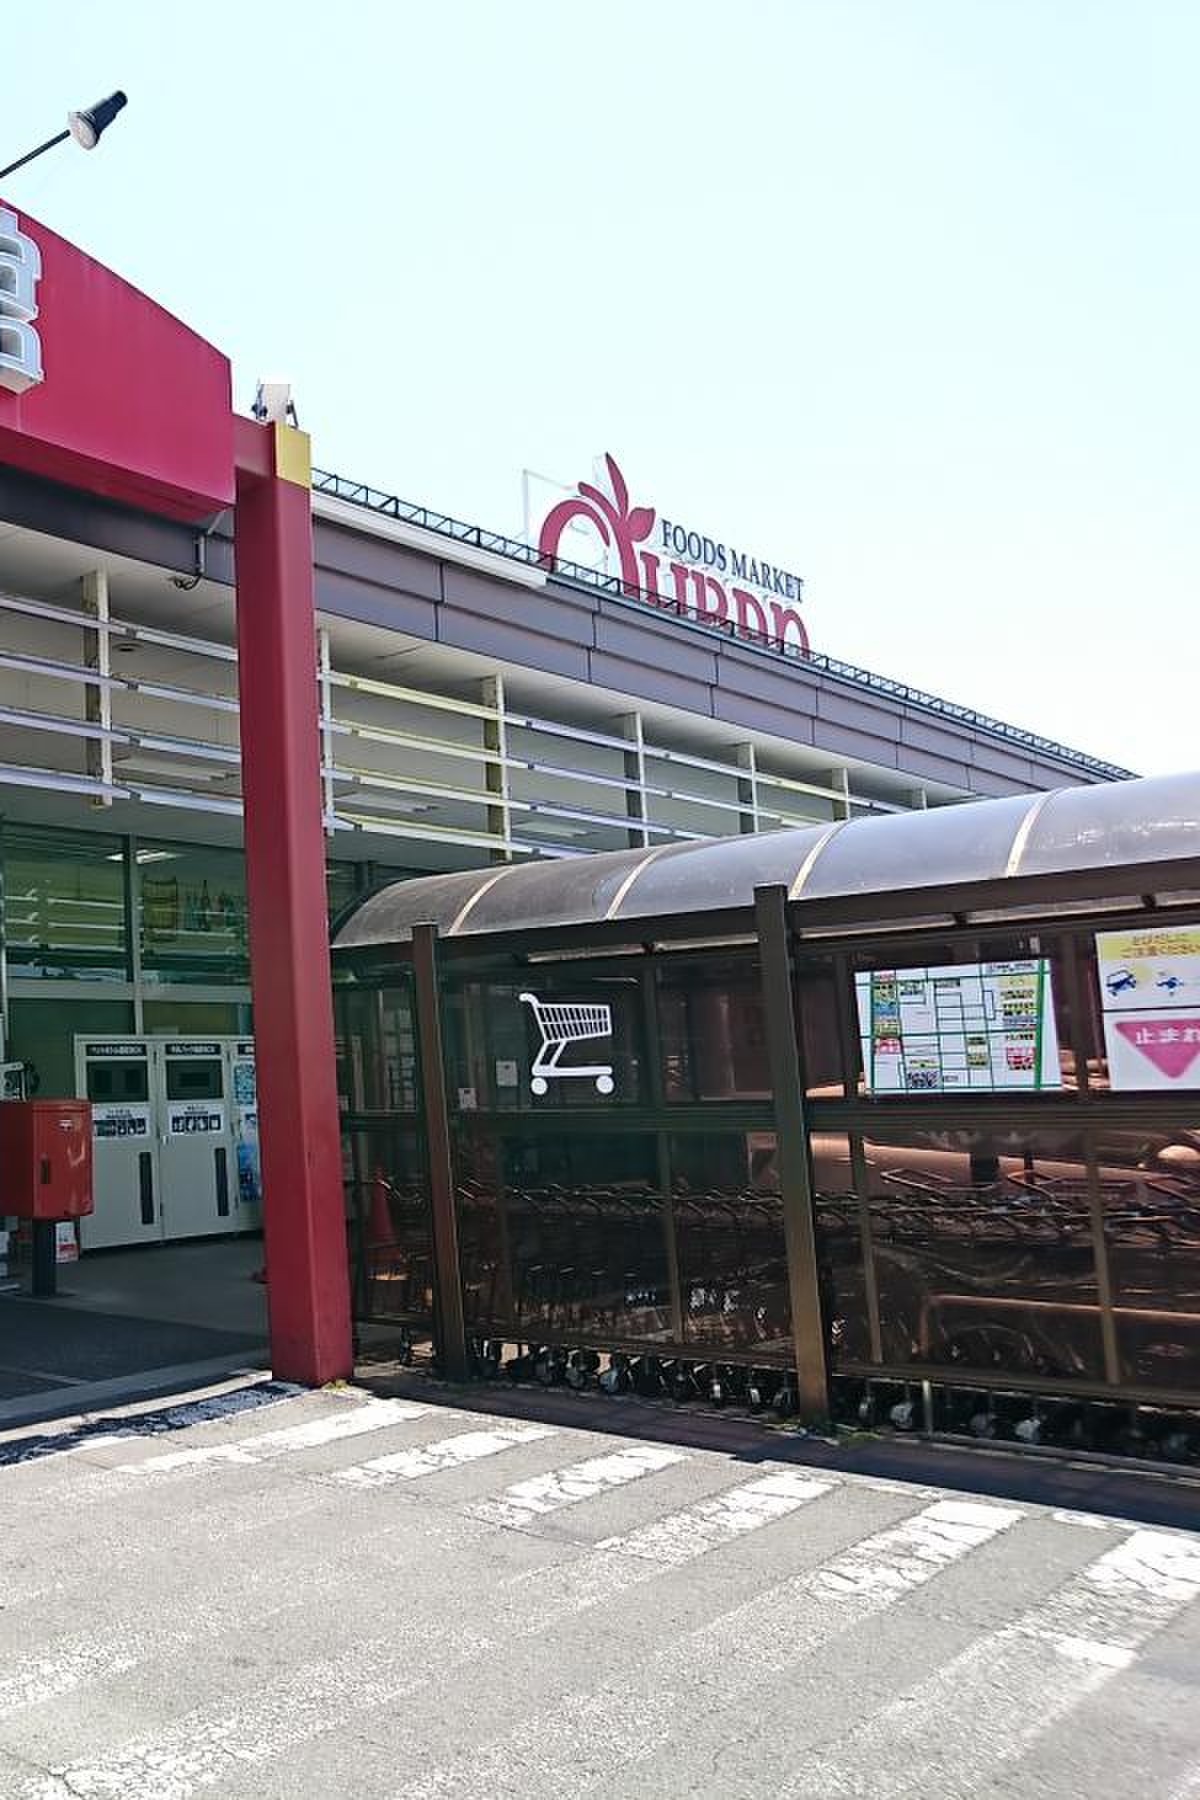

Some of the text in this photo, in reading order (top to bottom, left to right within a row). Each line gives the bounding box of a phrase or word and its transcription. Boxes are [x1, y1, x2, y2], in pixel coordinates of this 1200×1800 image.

[662, 518, 804, 603] FOODS MARKET
[1136, 1026, 1200, 1045] 止まれ
